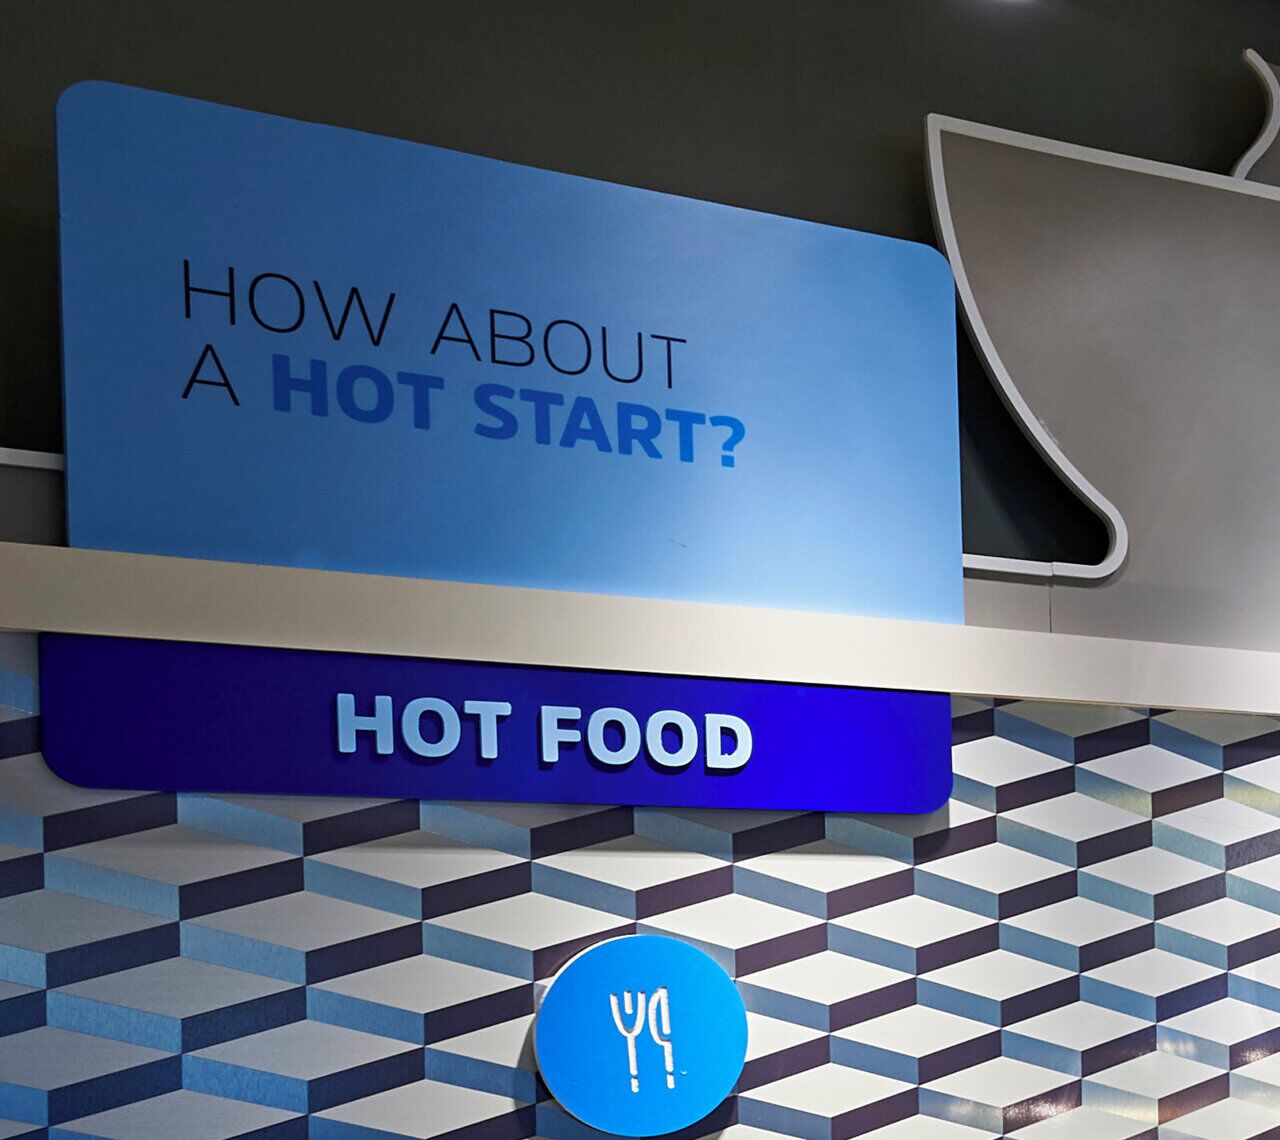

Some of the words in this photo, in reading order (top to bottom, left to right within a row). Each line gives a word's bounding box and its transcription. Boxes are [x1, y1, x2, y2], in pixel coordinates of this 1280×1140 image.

[181, 258, 397, 348] HOW
[429, 301, 688, 389] ABOUT
[181, 343, 241, 407] A
[271, 353, 445, 429] HOT
[473, 382, 747, 469] START?
[335, 692, 513, 762] HOT
[539, 705, 755, 773] FOOD
